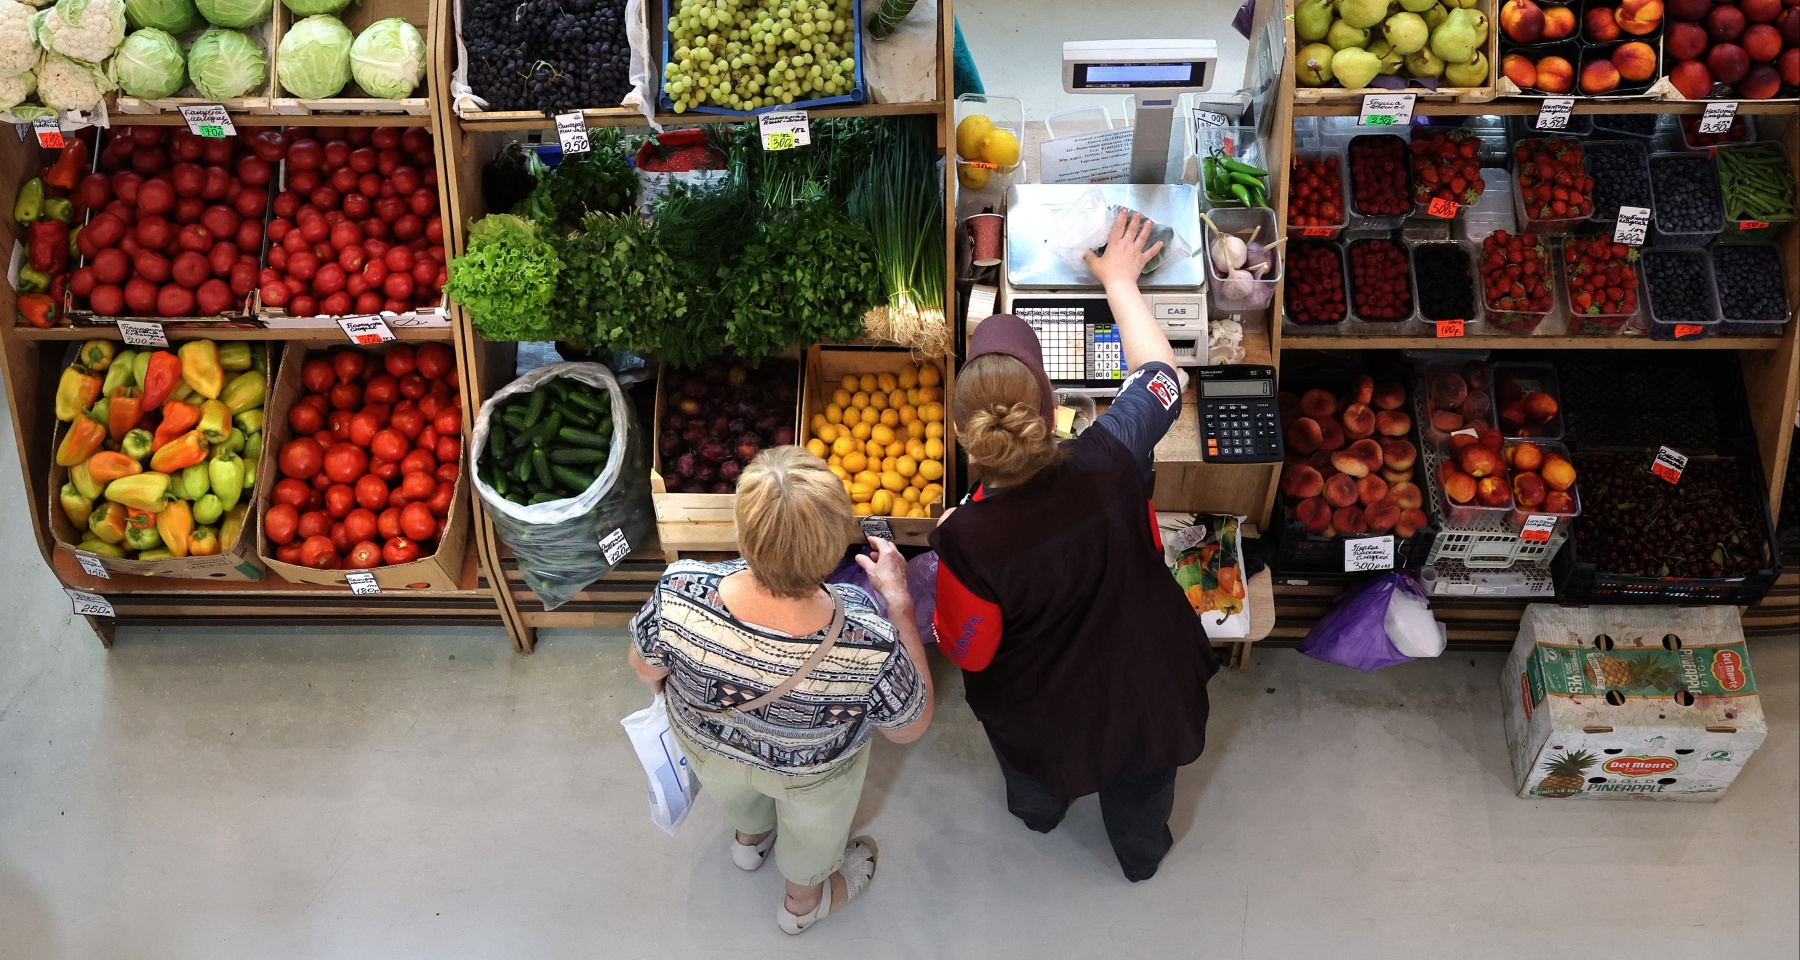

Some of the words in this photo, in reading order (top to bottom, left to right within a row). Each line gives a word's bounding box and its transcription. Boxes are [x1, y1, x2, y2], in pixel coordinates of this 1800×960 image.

[563, 140, 589, 153] 250
[1431, 204, 1454, 217] 500р
[80, 603, 111, 615] 250р
[1722, 652, 1734, 665] Del
[1679, 649, 1703, 696] PINEAPPLE
[1695, 656, 1709, 687] GOLD
[1725, 665, 1738, 689] Monte
[1567, 675, 1584, 694] YES
[1610, 761, 1630, 769] Del
[1634, 761, 1673, 769] Monte
[1587, 783, 1666, 793] PINEAPPLE
